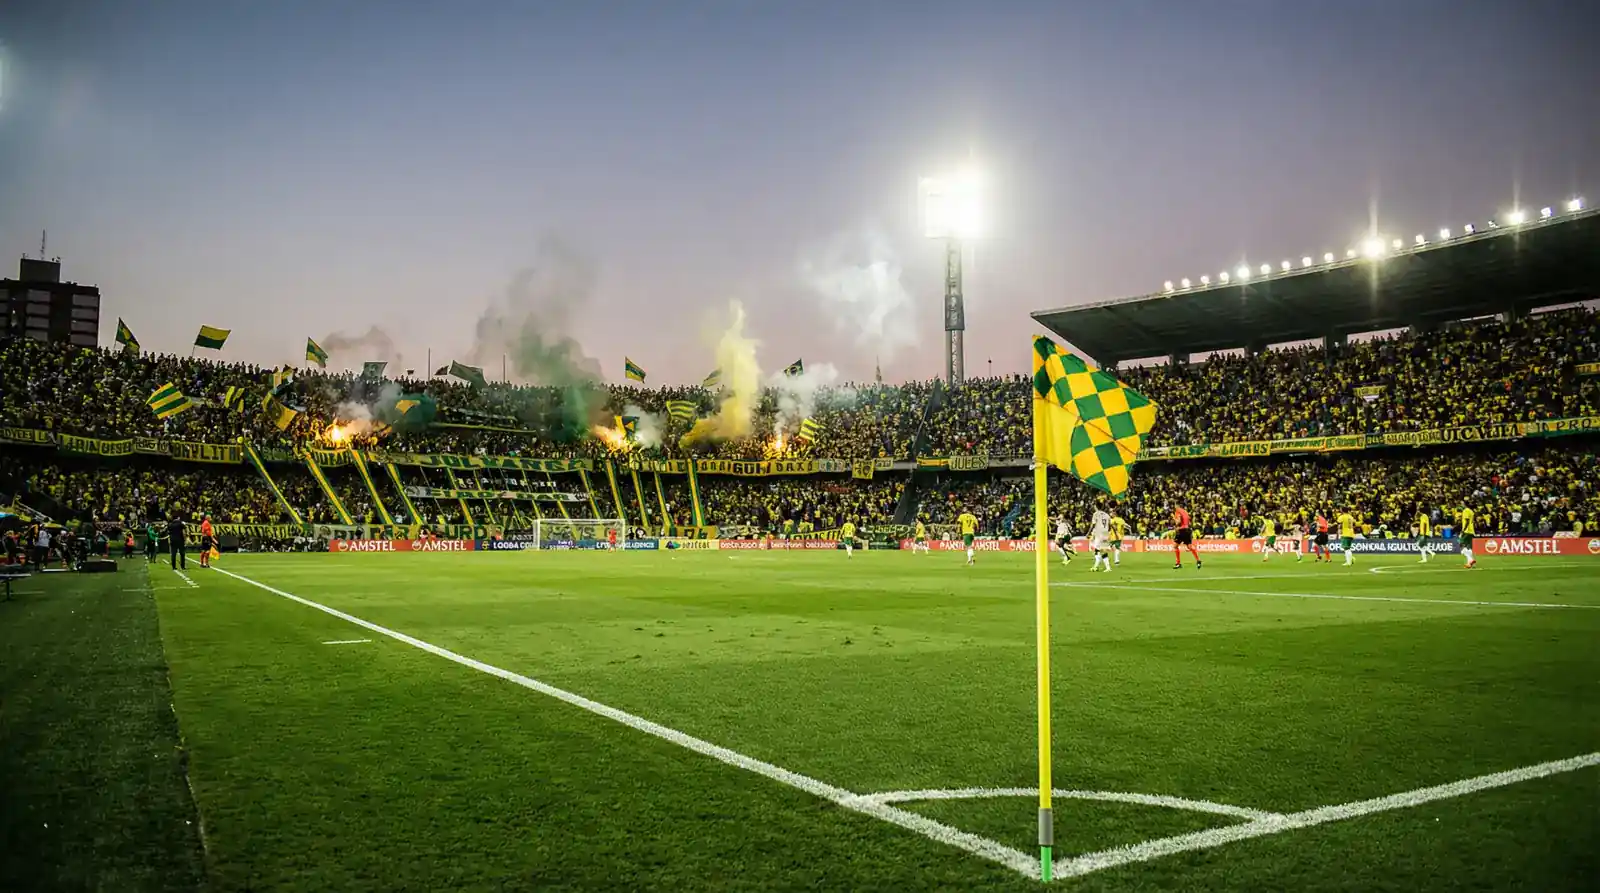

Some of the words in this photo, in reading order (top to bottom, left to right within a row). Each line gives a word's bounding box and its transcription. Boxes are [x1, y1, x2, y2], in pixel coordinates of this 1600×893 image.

[349, 540, 397, 551] AMSTEL
[422, 540, 467, 551] AMSTEL
[974, 541, 1000, 551] AMSTEL
[1499, 539, 1561, 553] AMSTEL
